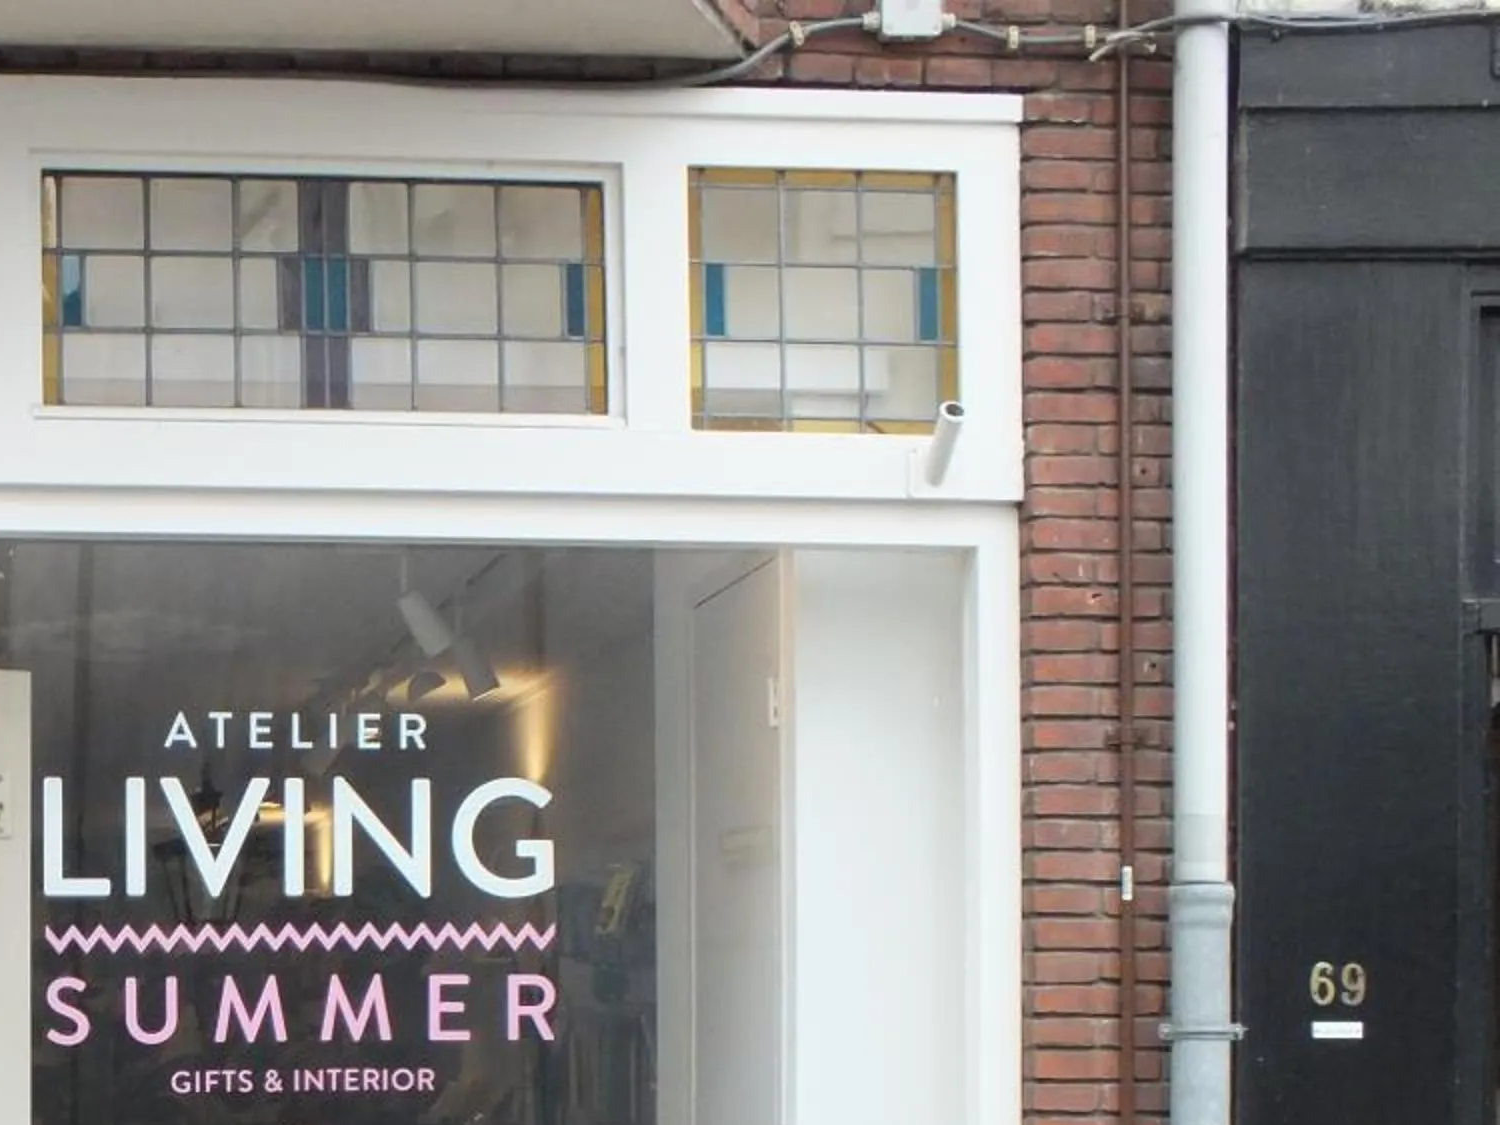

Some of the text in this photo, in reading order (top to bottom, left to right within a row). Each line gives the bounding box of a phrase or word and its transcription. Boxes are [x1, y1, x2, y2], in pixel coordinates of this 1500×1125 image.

[164, 711, 428, 749] ATELIER
[43, 776, 556, 898] LIVING
[1309, 961, 1366, 1006] 69
[46, 974, 557, 1046] SUMMER
[171, 1068, 436, 1094] GIFTS & INTERIOR
